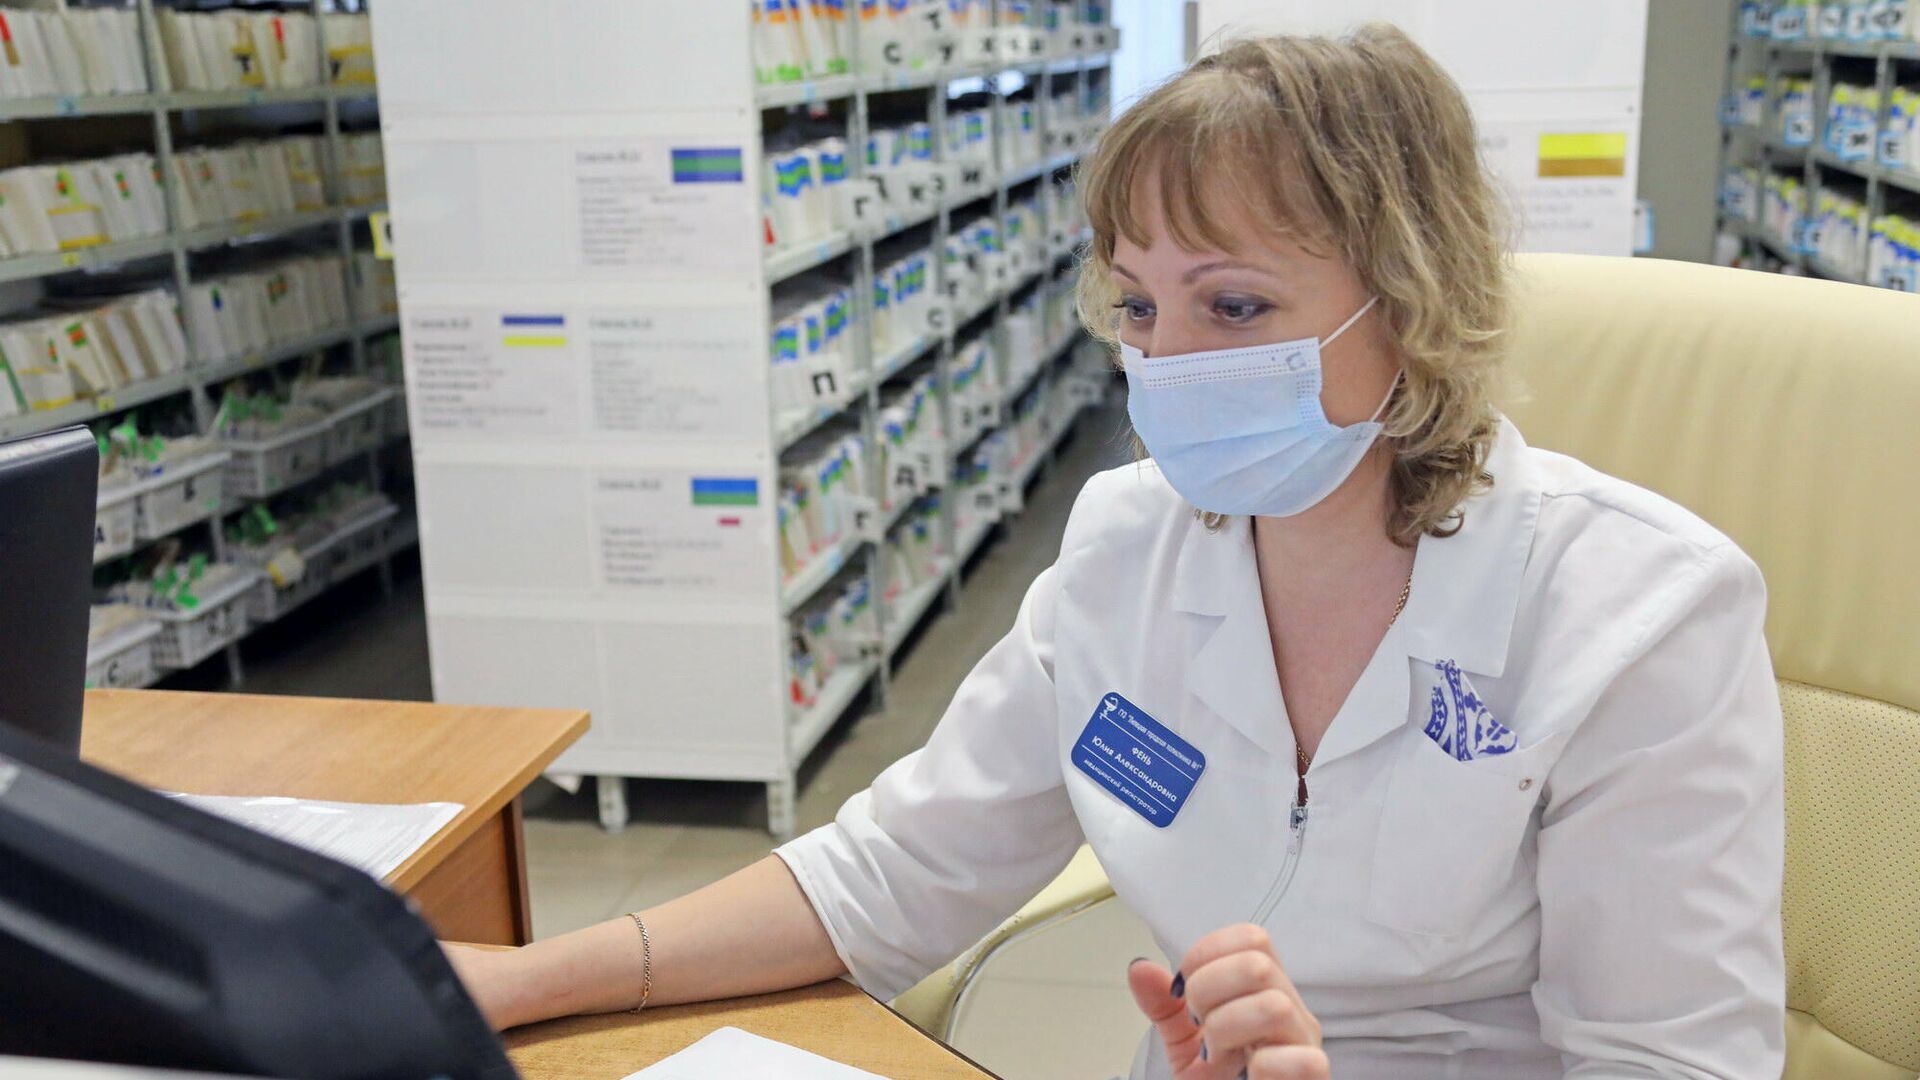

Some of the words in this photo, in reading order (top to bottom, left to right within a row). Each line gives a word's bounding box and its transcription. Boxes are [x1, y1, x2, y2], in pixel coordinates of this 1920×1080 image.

[884, 42, 901, 64] С
[927, 307, 944, 329] С
[812, 371, 836, 396] П
[1131, 747, 1151, 766] ФЕНЬ
[1092, 736, 1114, 756] Юлия
[1115, 753, 1177, 802] Александровна
[1083, 759, 1121, 788] медицинский
[1120, 786, 1157, 815] регистратор
